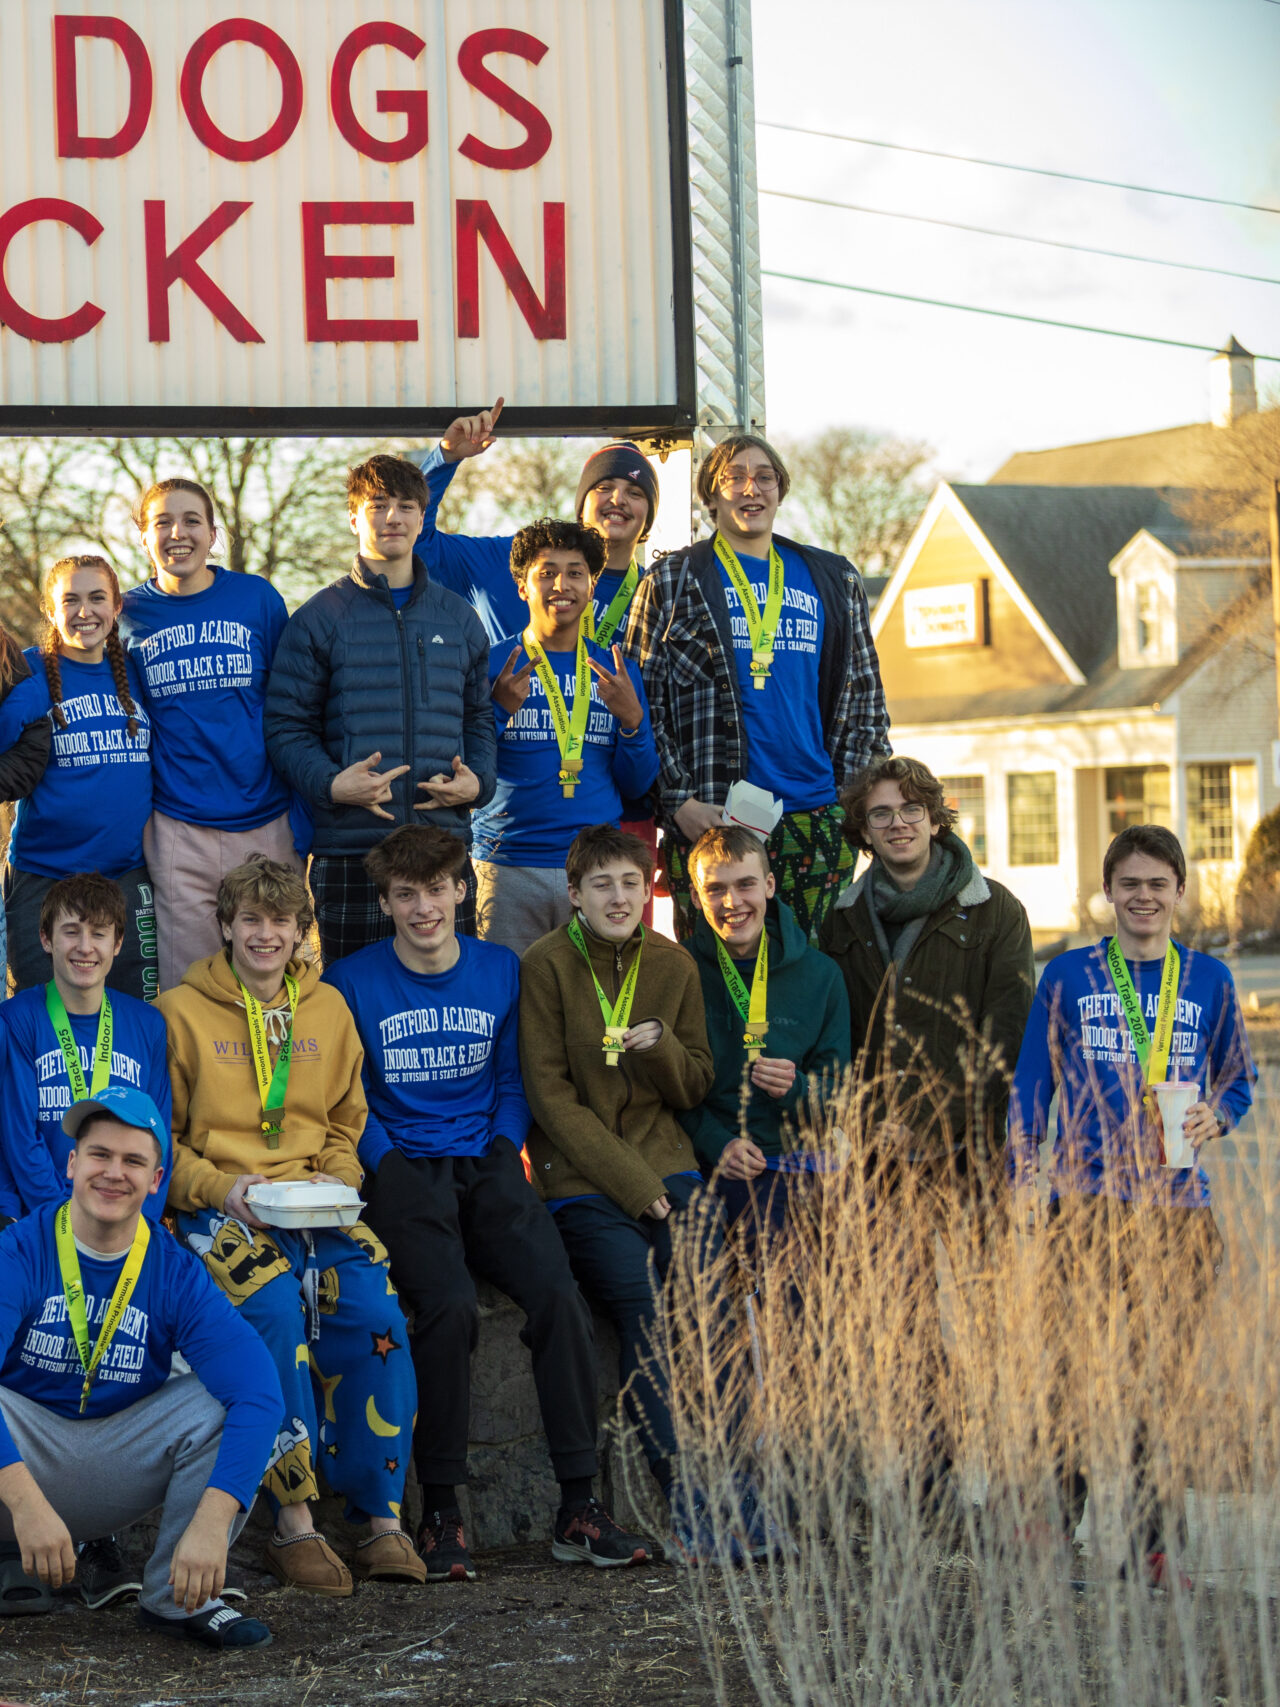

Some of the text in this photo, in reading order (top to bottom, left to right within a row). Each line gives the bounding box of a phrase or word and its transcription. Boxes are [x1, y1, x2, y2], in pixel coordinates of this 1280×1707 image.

[54, 15, 552, 170] DOGS
[742, 588, 757, 625] Association
[140, 620, 252, 666] THETFORD ACADEMY
[786, 618, 793, 638] &
[795, 618, 818, 642] FIELD
[788, 641, 816, 654] CHAMPIONS
[145, 653, 253, 687] INDOOR TRACK & FIELD
[161, 682, 187, 697] DIVISION
[189, 681, 195, 692] II
[197, 678, 217, 690] STATE
[219, 677, 253, 688] CHAMPIONS
[553, 695, 566, 734] Association
[589, 712, 613, 733] FIELD
[53, 732, 91, 756] INDOOR
[90, 729, 124, 752] TRACK
[520, 731, 548, 741] DIVISION
[57, 753, 127, 768] 2025 DIVISION II STATE
[728, 976, 744, 1000] Track
[1108, 942, 1124, 979] Indoor
[1120, 981, 1136, 1014] Track
[1130, 1016, 1146, 1045] 2025
[380, 1006, 495, 1047] THETFORD ACADEMY
[1156, 987, 1172, 1052] Vermont Principals'
[98, 1023, 111, 1062] Indoor
[253, 1016, 269, 1086] Vermont Principals'
[383, 1040, 492, 1070] INDOOR TRACK & FIELD
[1081, 1025, 1118, 1050] INDOOR
[1171, 1032, 1198, 1053] FIELD
[59, 1028, 83, 1095] Track 2025
[1082, 1050, 1136, 1063] 2025 DIVISION II
[385, 1069, 458, 1083] 2025 DIVISION II STATE
[100, 1278, 134, 1347] Vermont Principals'
[24, 1328, 65, 1359] INDOOR
[111, 1344, 145, 1370] FIELD
[20, 1352, 35, 1366] 2025
[37, 1358, 66, 1373] DIVISION
[67, 1362, 73, 1372] II
[99, 1369, 141, 1383] CHAMPIONS
